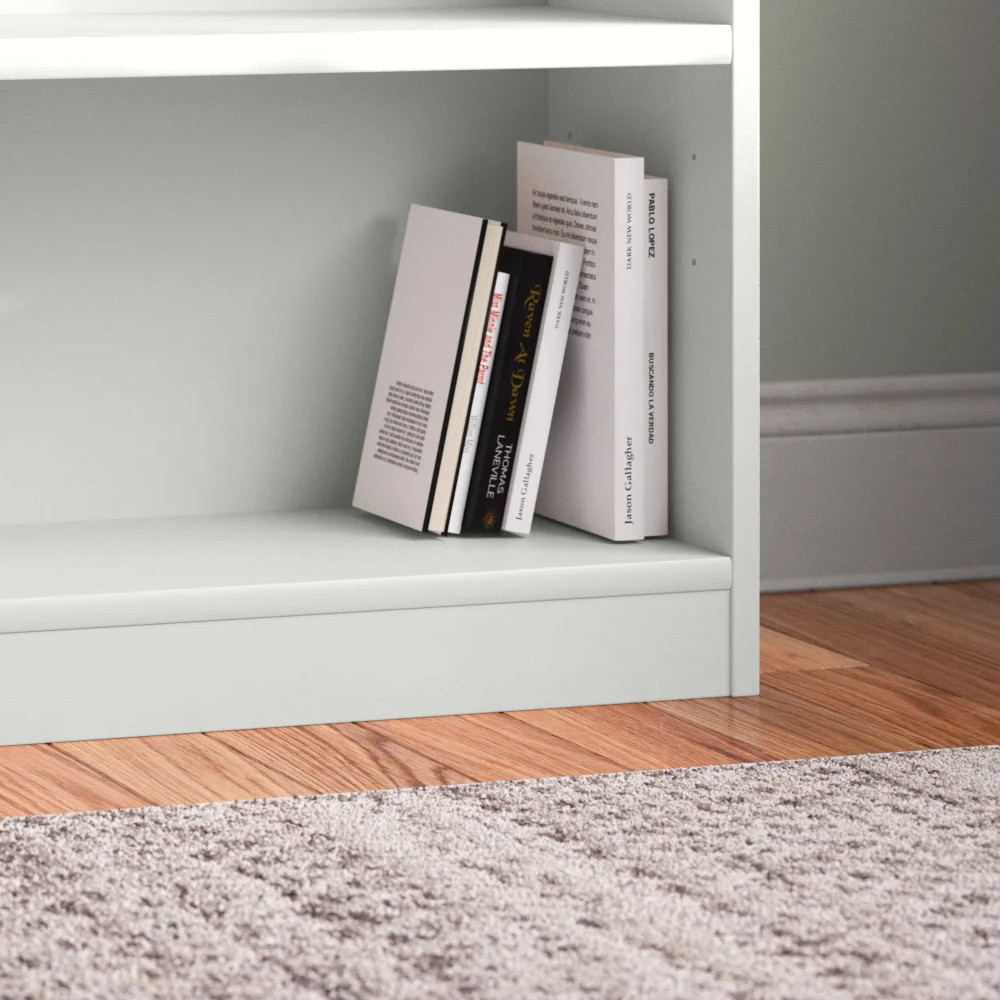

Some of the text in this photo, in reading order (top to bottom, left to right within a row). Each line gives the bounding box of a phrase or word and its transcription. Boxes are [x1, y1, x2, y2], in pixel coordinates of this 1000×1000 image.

[648, 192, 656, 258] PABLO LOPEZ
[506, 284, 542, 422] Raven At Dawn
[648, 399, 654, 410] LA
[486, 434, 505, 499] LANEVILLE
[496, 444, 513, 494] THOMAS
[515, 453, 534, 520] Jason Gallagher
[624, 436, 634, 524] Jason Gallagher
